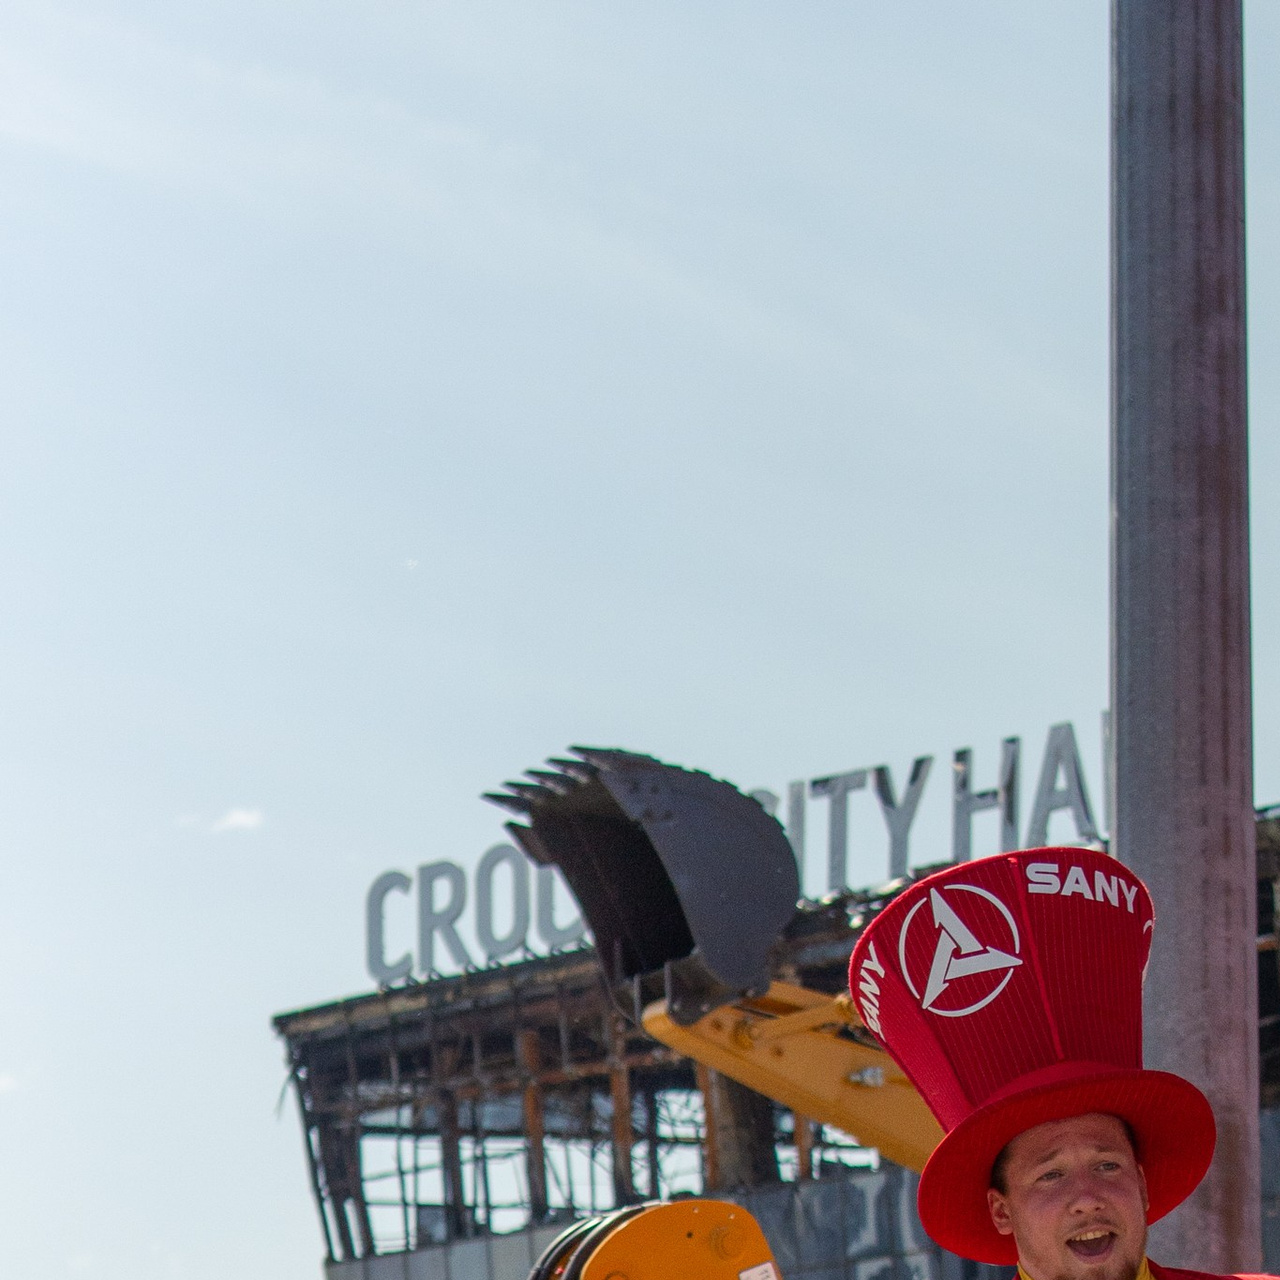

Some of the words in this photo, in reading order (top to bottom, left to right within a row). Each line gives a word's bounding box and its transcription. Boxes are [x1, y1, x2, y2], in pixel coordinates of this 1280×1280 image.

[750, 755, 934, 893] ITY
[953, 709, 1111, 864] HA
[1026, 863, 1138, 914] SANY
